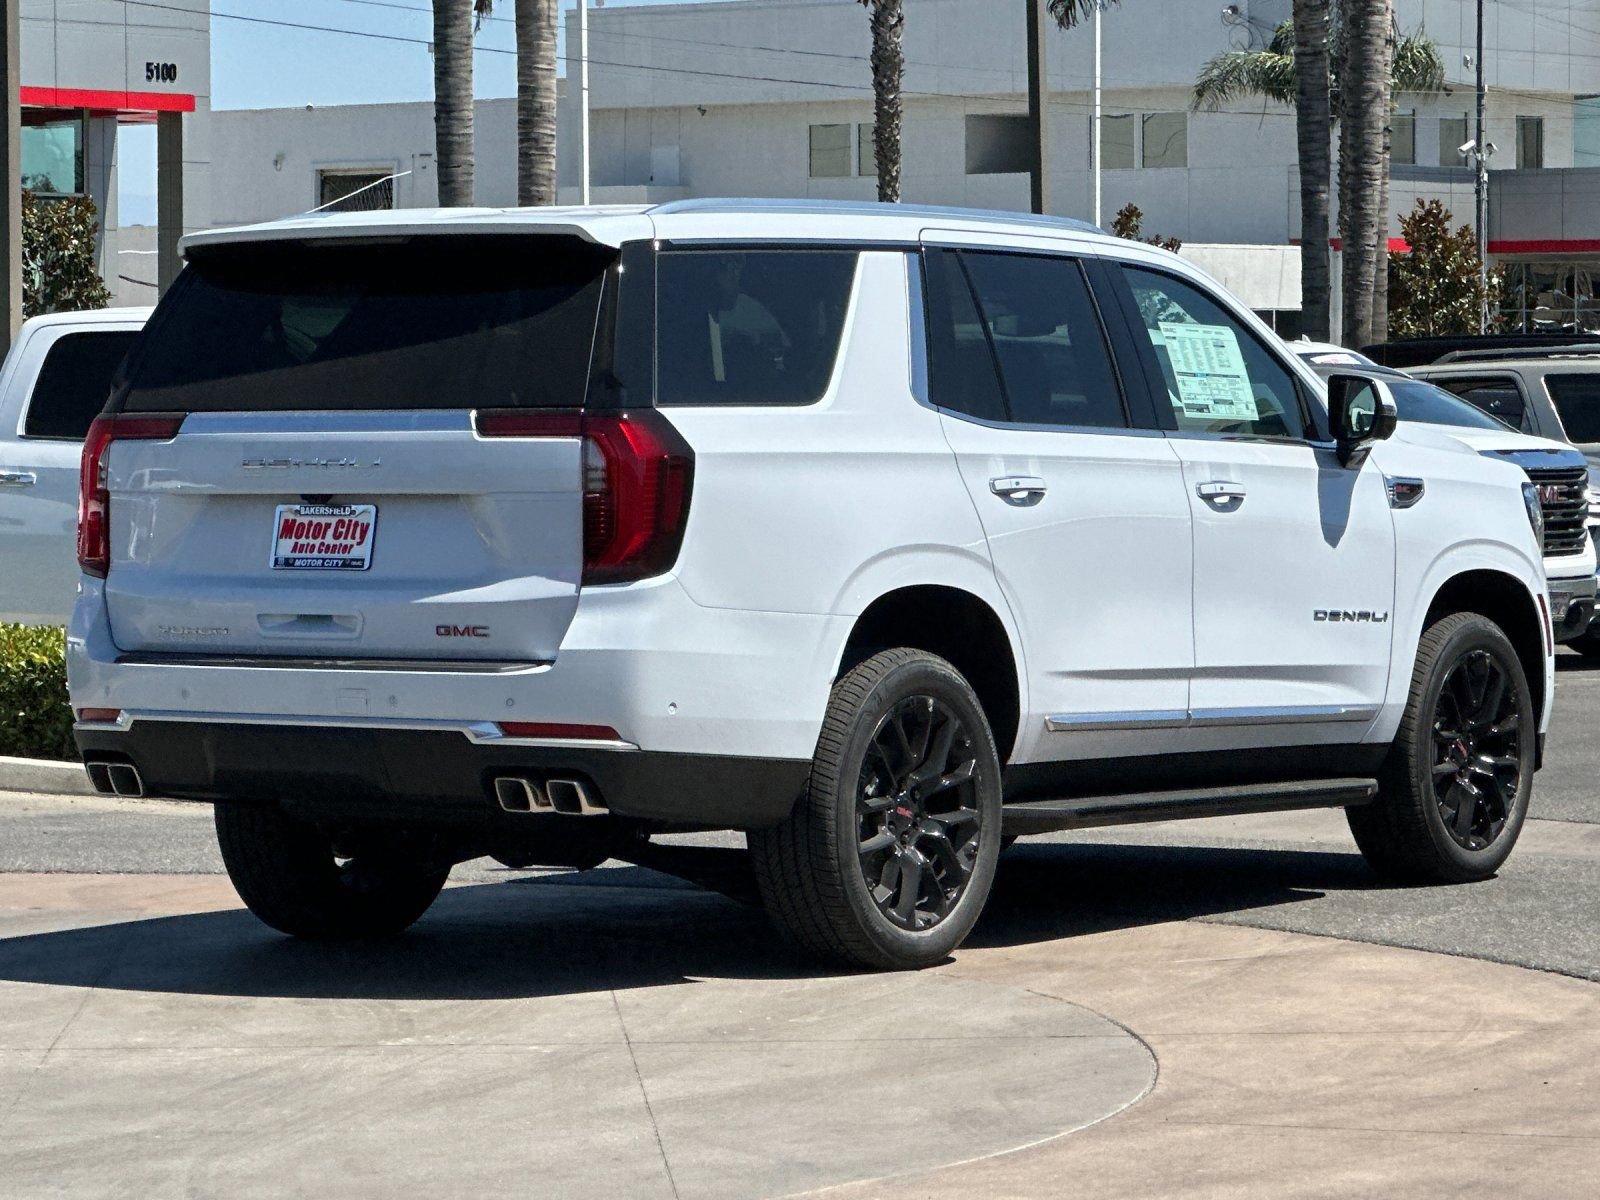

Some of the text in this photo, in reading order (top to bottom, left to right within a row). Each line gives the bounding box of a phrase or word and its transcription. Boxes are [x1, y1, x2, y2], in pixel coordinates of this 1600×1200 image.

[145, 61, 177, 83] 5100
[1536, 484, 1569, 504] MC
[300, 506, 351, 516] BAKERSFIELD
[280, 518, 370, 546] Motor City
[291, 541, 354, 555] Auto Center
[294, 558, 322, 567] MOTOR
[324, 559, 344, 567] CITY
[1313, 609, 1388, 623] DENALI
[435, 624, 490, 638] GMC
